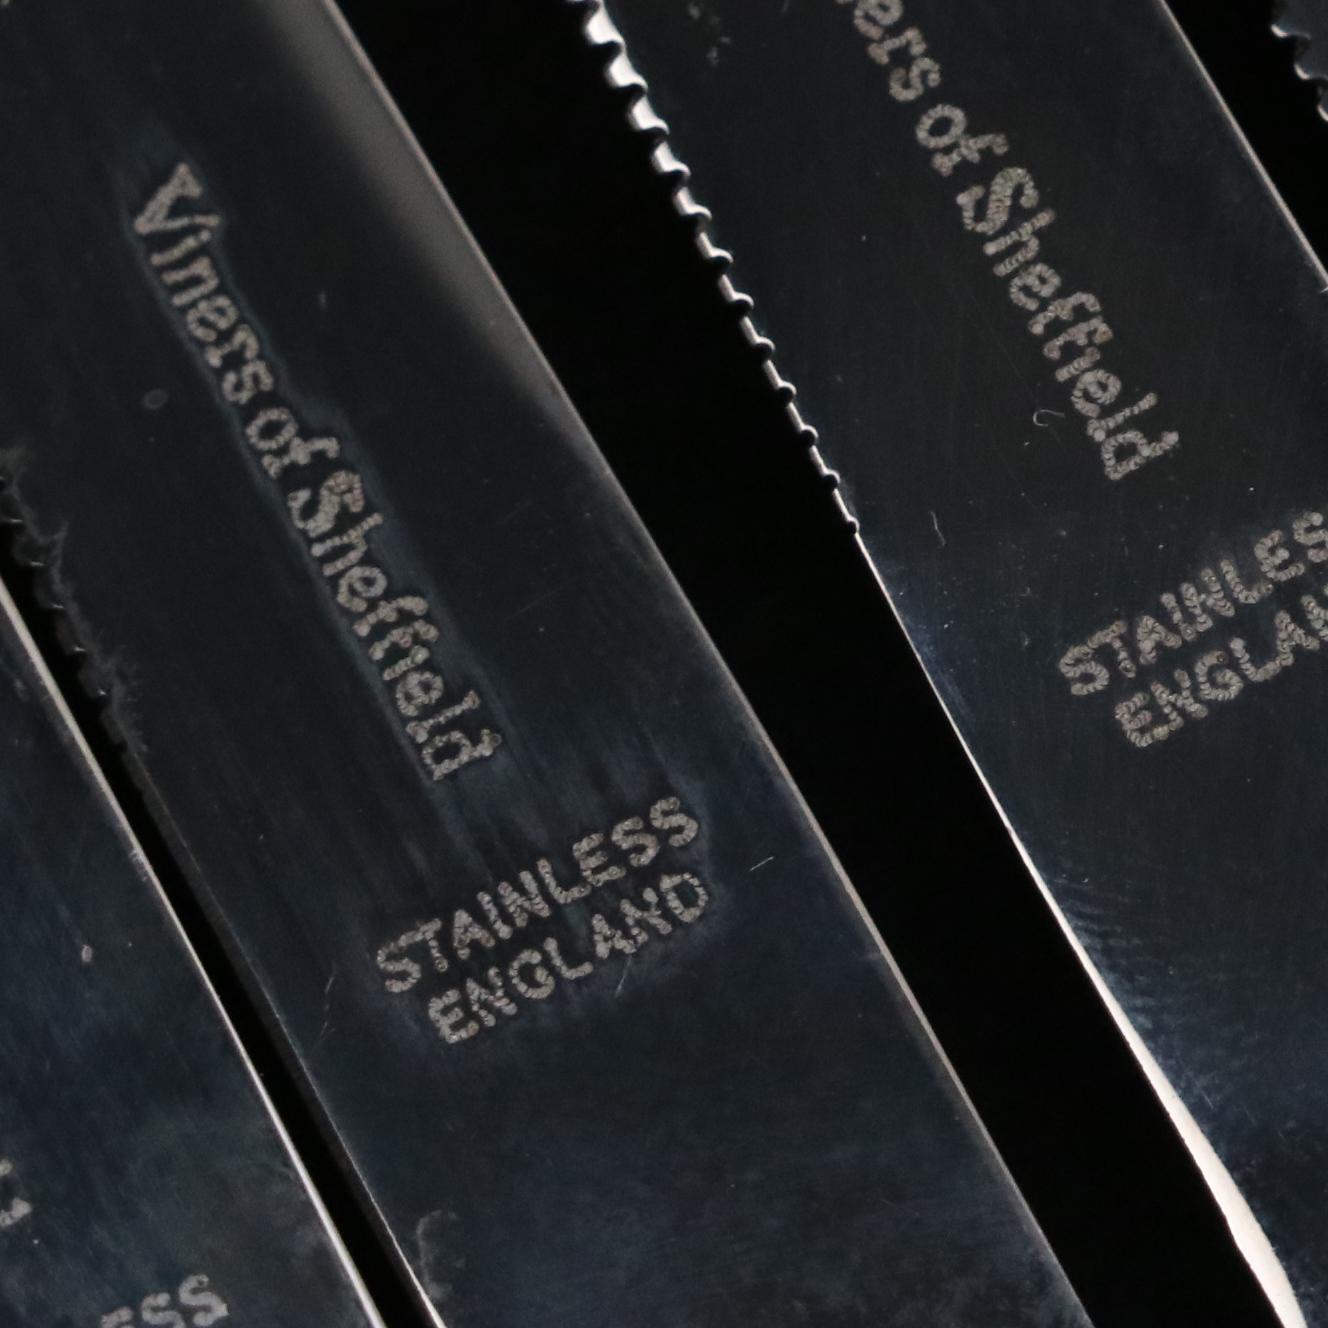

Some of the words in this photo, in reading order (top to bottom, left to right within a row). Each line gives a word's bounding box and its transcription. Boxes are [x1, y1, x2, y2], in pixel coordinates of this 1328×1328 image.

[915, 103, 1008, 177] of
[133, 162, 275, 406] Viners
[956, 166, 1180, 480] Sheffield
[244, 407, 339, 477] of
[287, 471, 502, 781] Sheffield
[375, 795, 700, 994] STAINLESS
[427, 872, 712, 1046] ENGLAND
